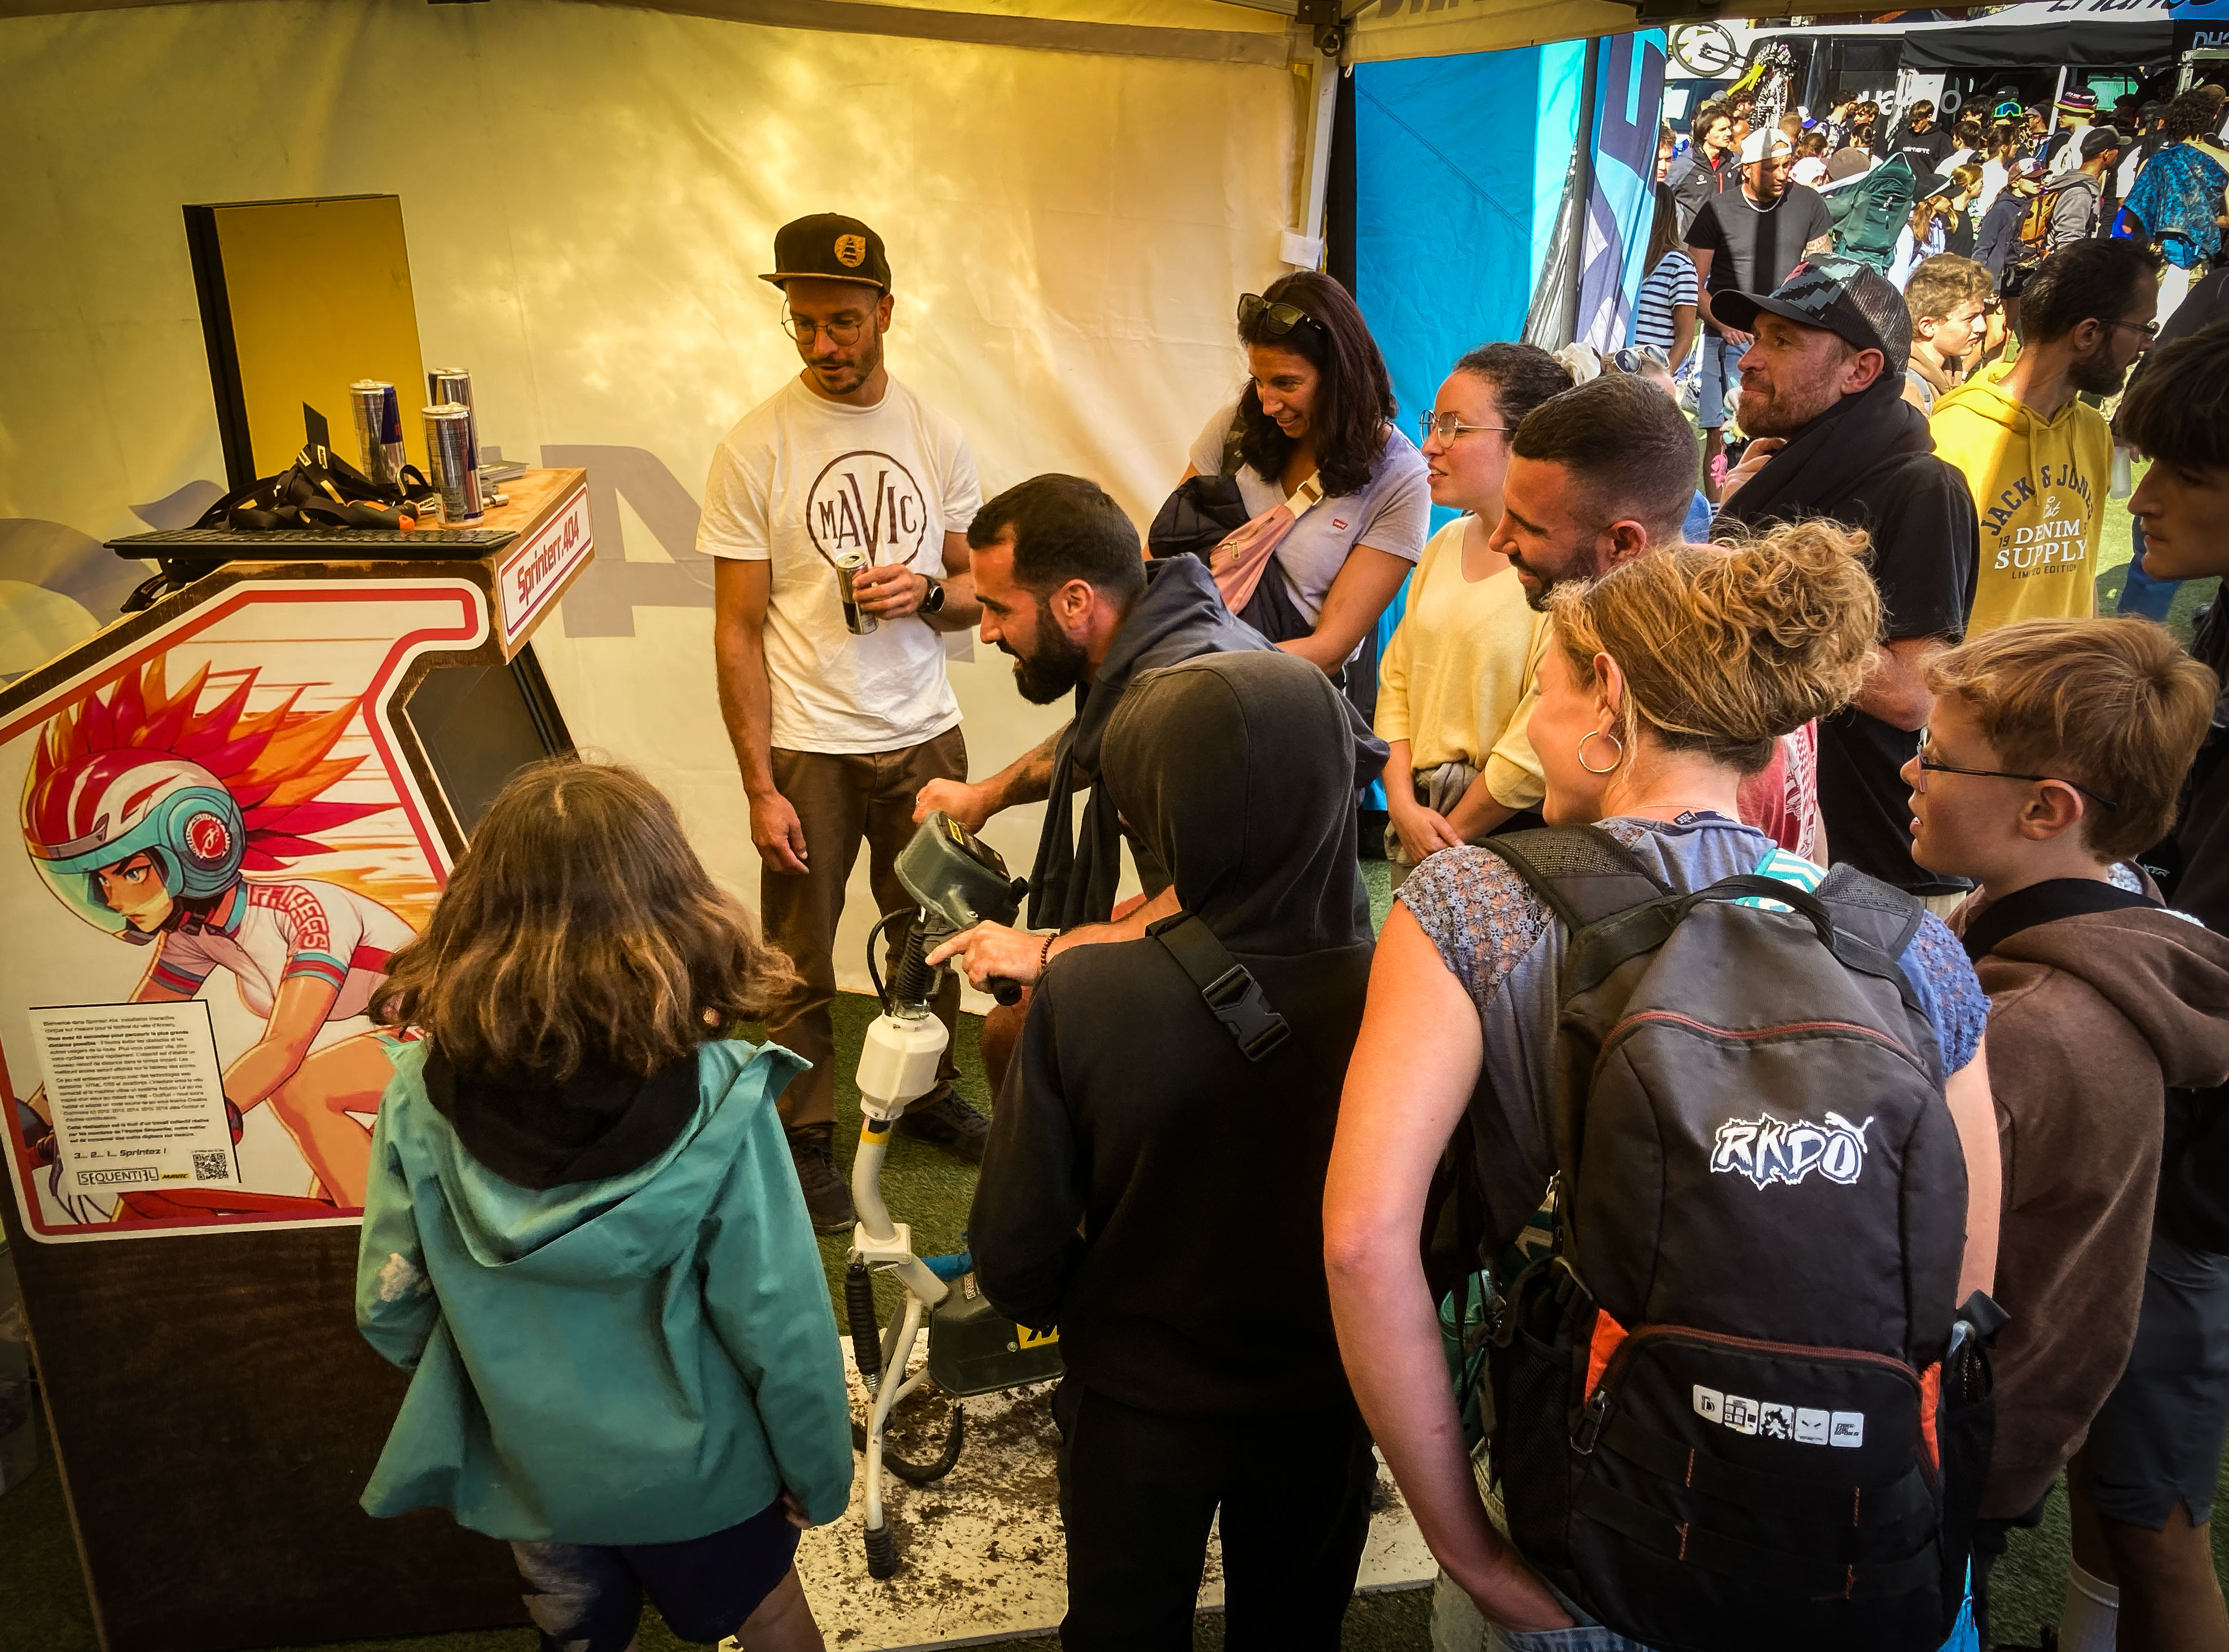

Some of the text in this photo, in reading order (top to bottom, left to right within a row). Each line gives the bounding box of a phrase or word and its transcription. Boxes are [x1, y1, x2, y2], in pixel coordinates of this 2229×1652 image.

[1981, 477, 2035, 536] JACK
[2041, 465, 2051, 488] &
[2043, 496, 2061, 519] Est
[818, 471, 917, 567] MAVIC
[2015, 519, 2080, 545] DENIM
[1994, 539, 2087, 570] SUPPLY
[1998, 535, 2010, 548] 19
[517, 511, 579, 607] Sprinterr.404
[120, 1148, 161, 1157] Sprintez
